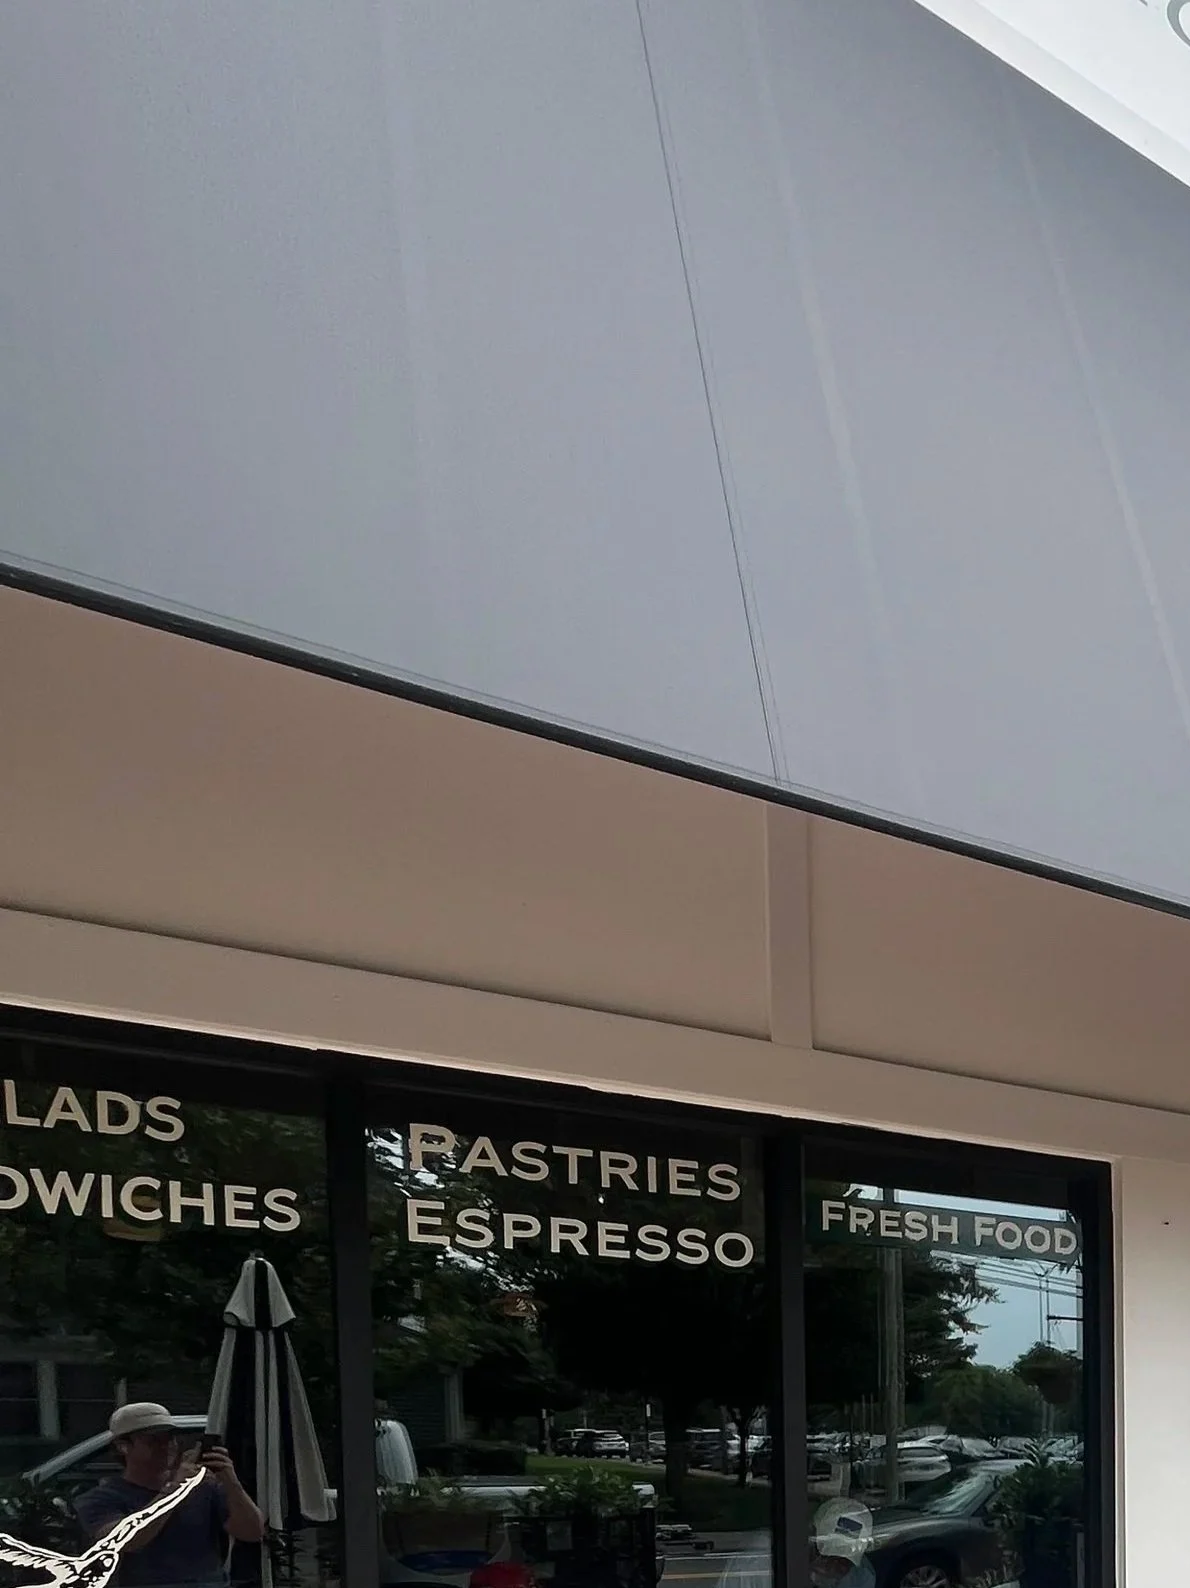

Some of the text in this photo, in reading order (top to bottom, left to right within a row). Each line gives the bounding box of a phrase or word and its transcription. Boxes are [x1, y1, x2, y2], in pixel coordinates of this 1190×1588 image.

[3, 1079, 185, 1142] LADS
[408, 1122, 742, 1201] PASTRIES
[406, 1198, 755, 1269] ESPRESSO
[821, 1199, 1078, 1256] FRESH FOOD
